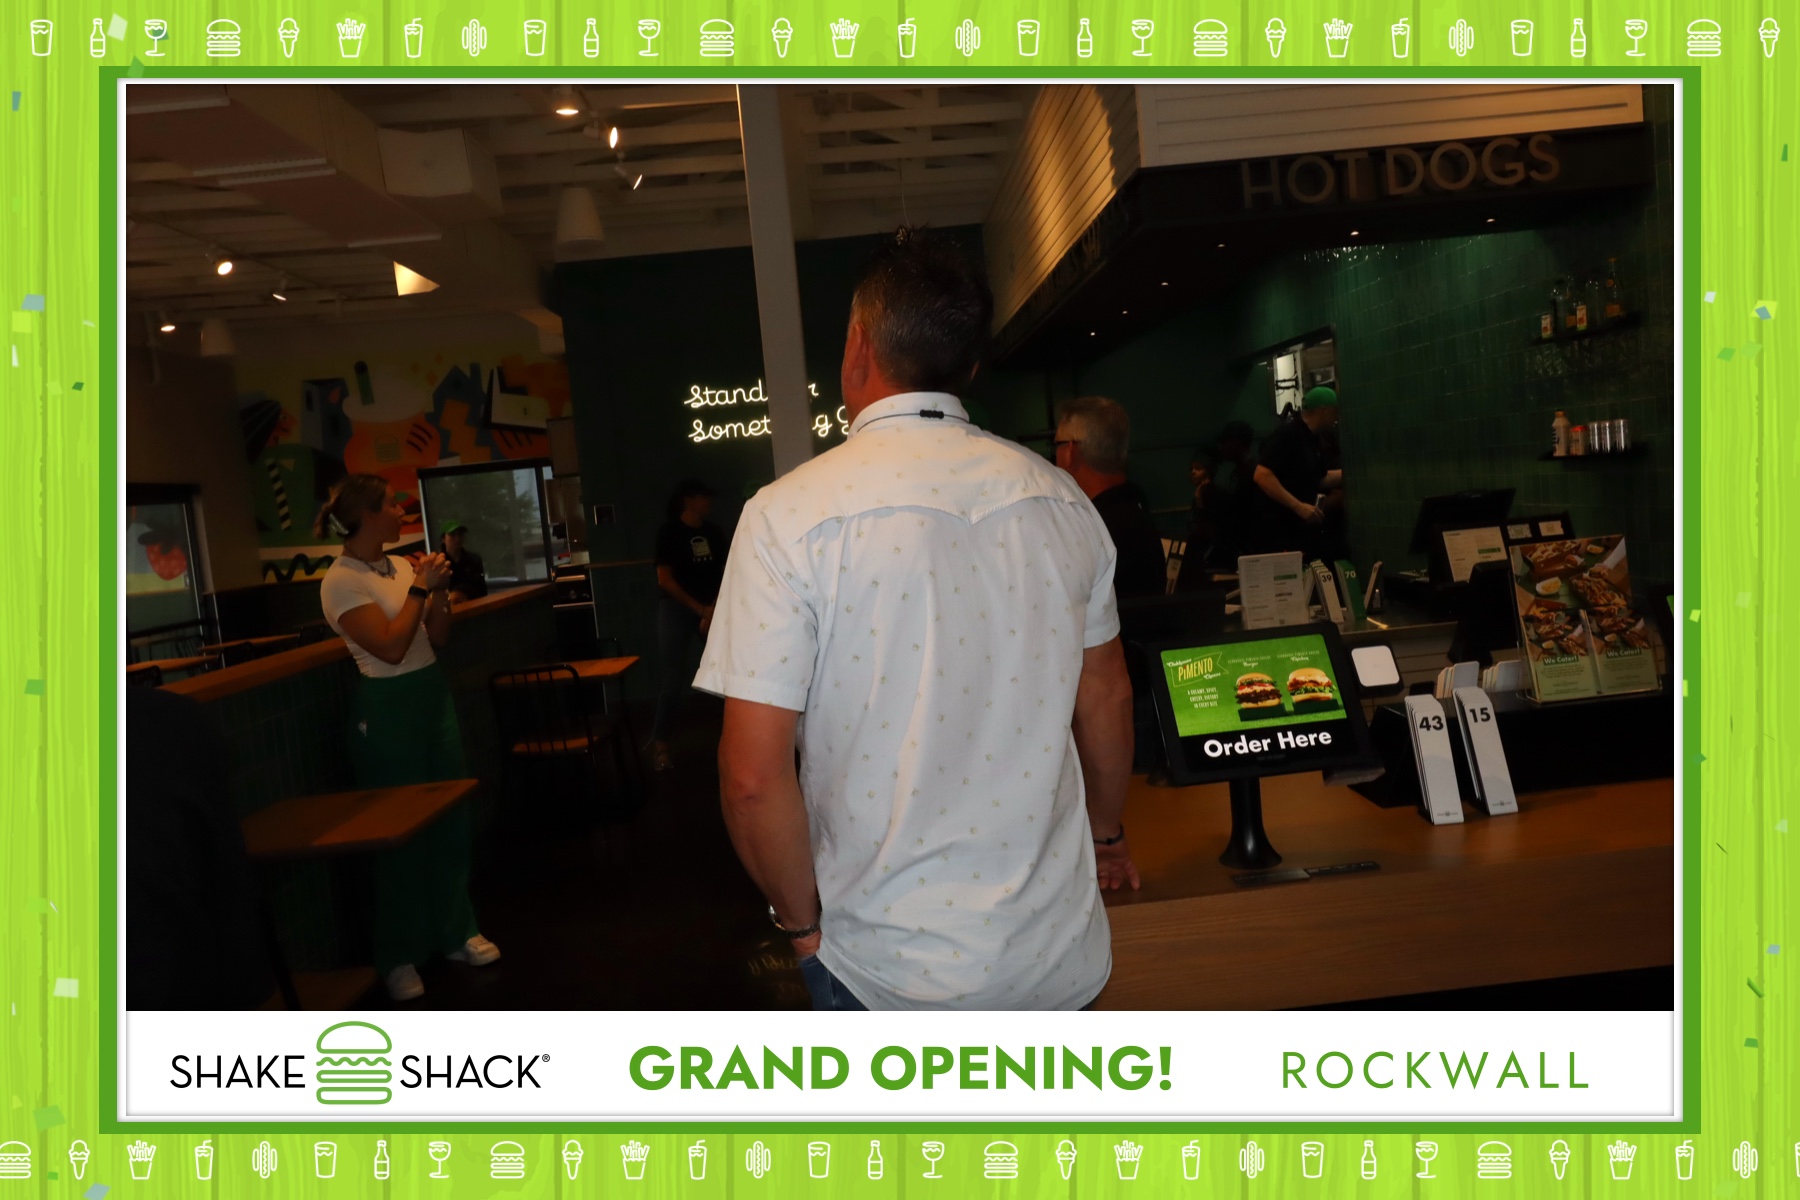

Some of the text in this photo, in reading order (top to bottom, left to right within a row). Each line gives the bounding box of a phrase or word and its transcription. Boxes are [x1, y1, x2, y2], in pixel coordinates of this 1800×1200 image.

[1240, 133, 1561, 209] HOT DOGS
[684, 378, 768, 409] Stand
[1321, 574, 1332, 583] 39
[1344, 570, 1357, 579] 70
[1544, 657, 1556, 665] We
[1419, 715, 1444, 731] 43
[1469, 707, 1491, 723] 15
[1203, 730, 1332, 758] Order Here
